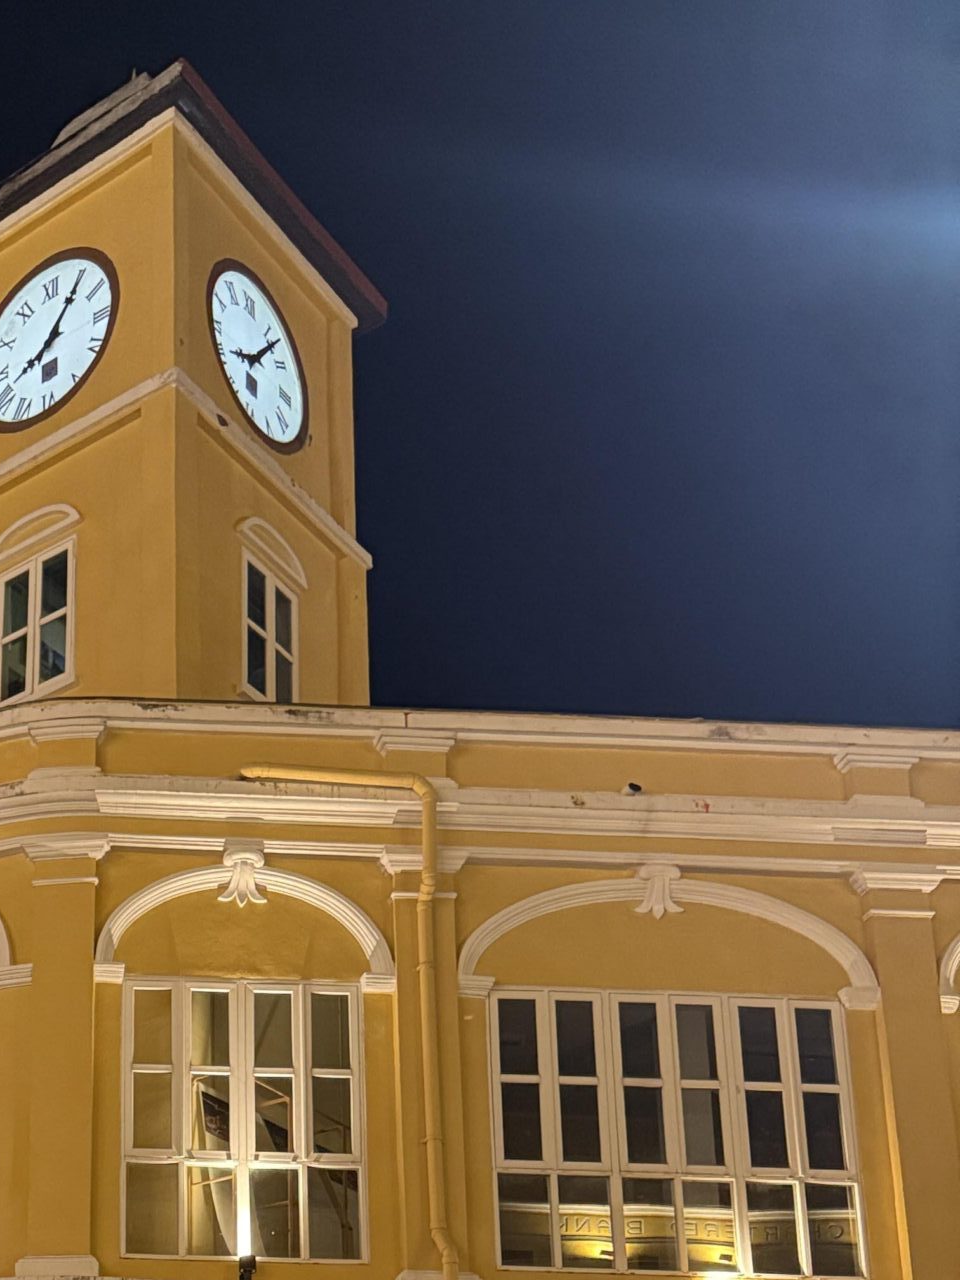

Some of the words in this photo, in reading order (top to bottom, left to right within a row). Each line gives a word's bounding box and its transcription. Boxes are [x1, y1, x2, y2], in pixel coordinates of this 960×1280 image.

[41, 275, 60, 305] XII
[242, 289, 256, 321] XII
[16, 300, 36, 326] XI
